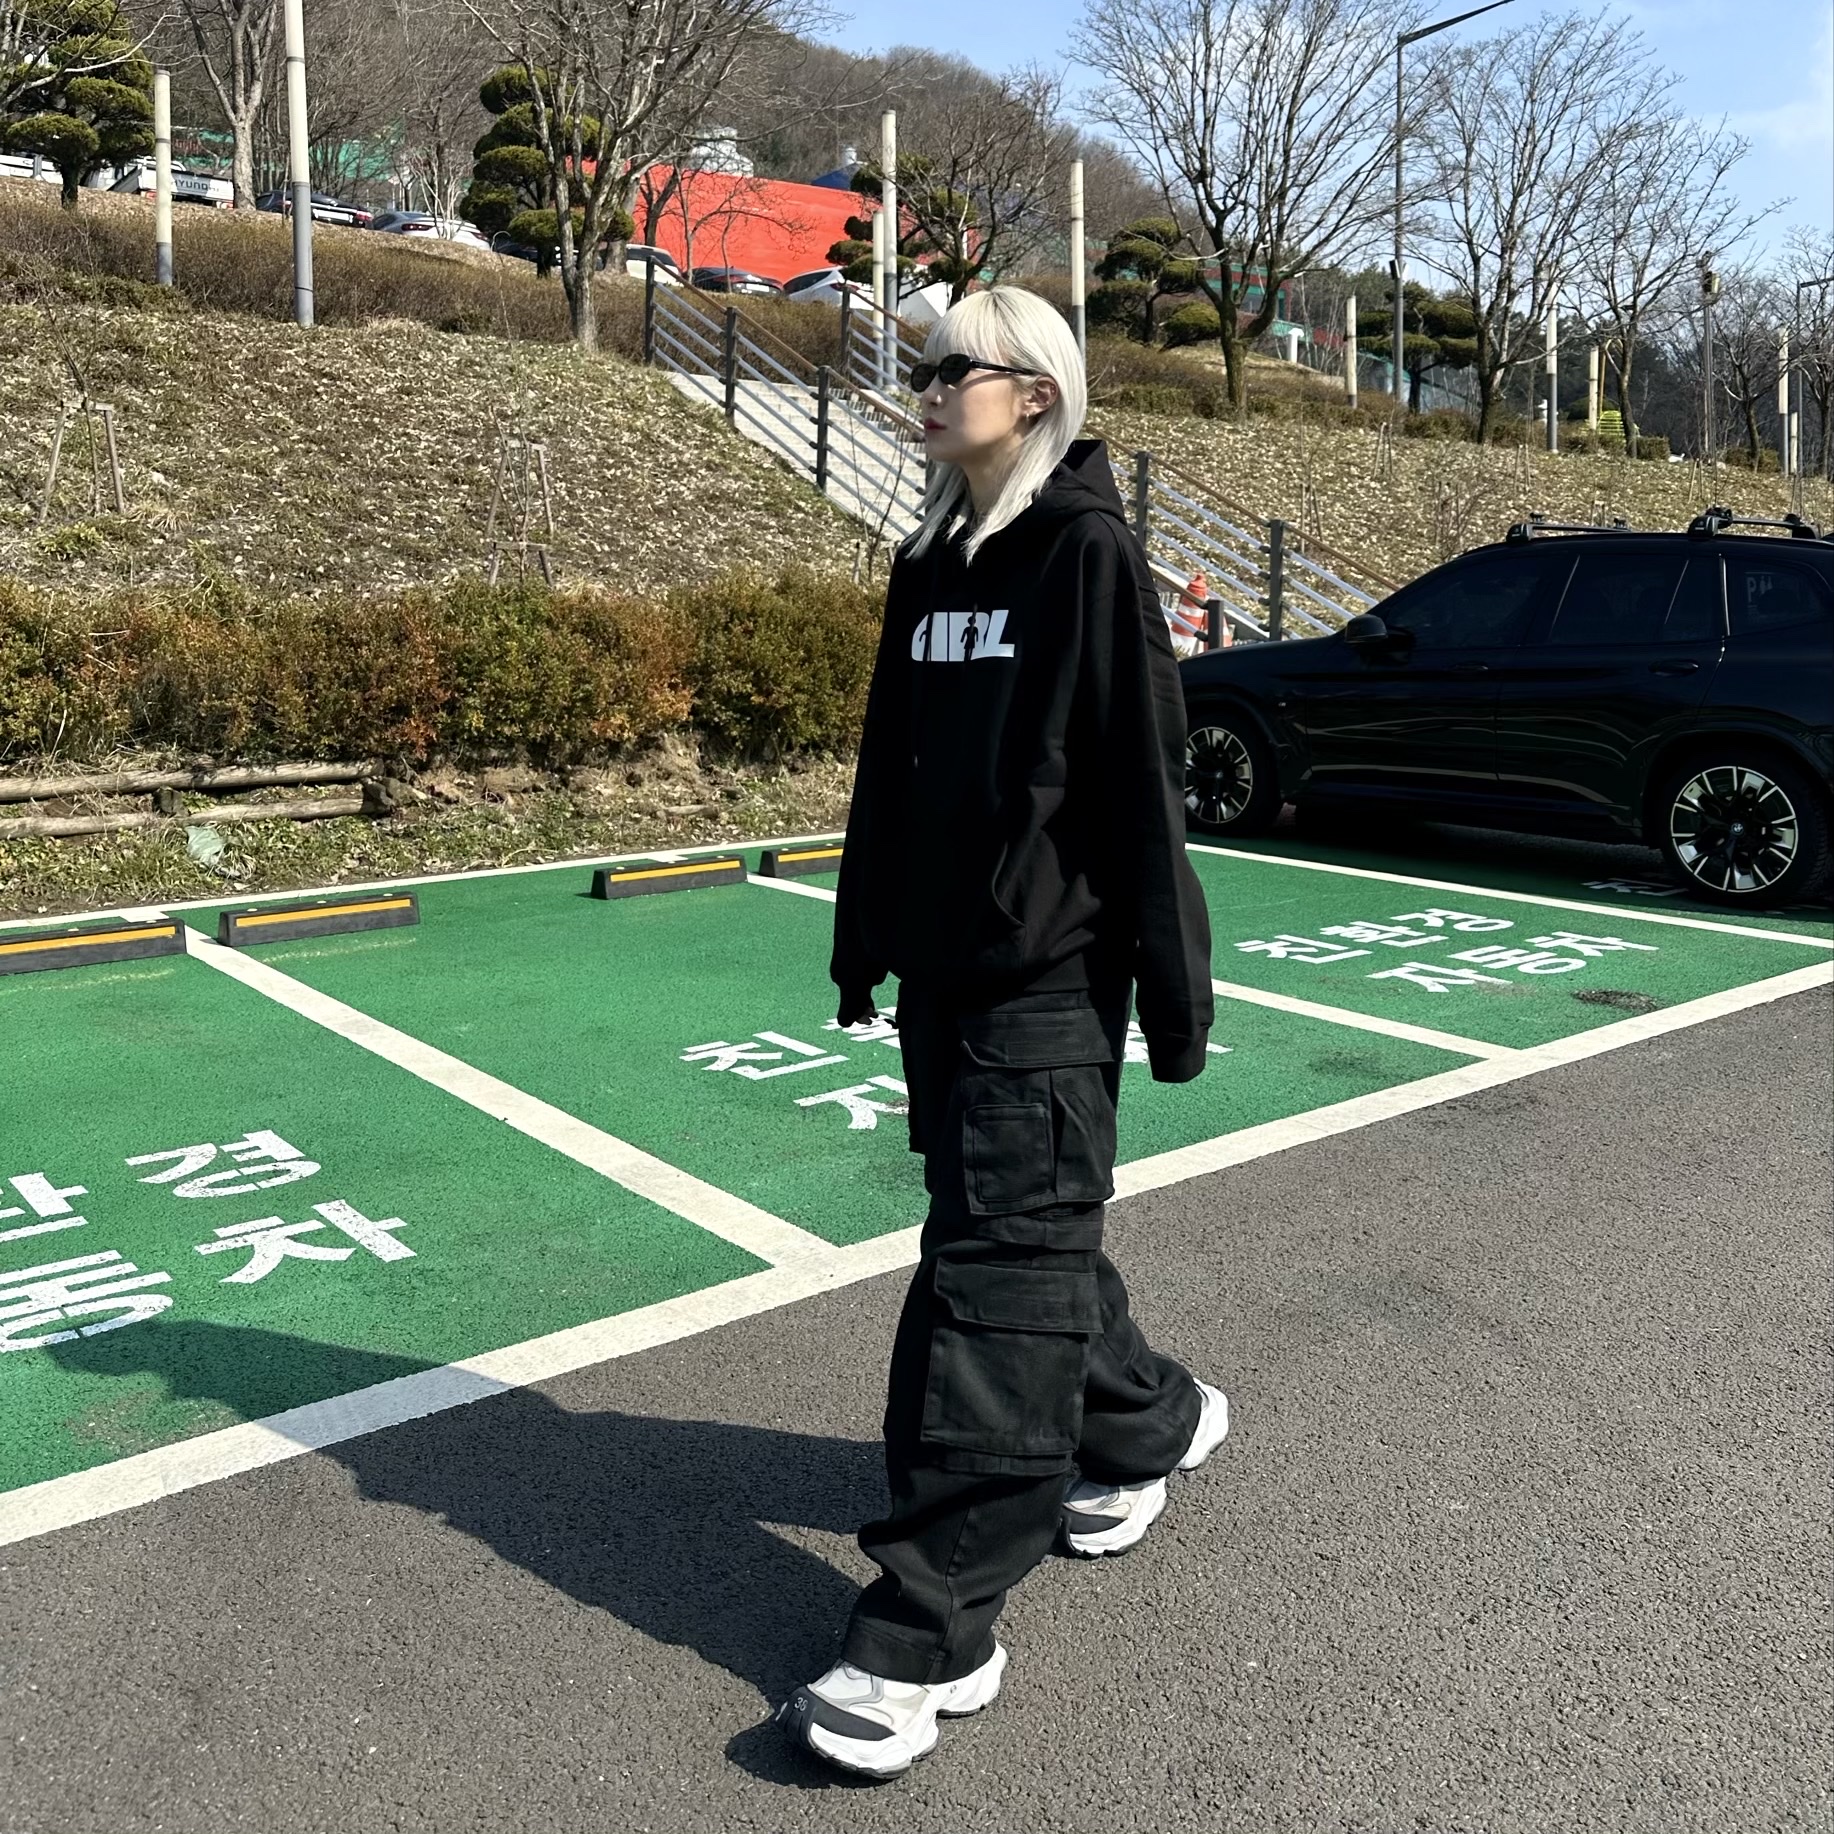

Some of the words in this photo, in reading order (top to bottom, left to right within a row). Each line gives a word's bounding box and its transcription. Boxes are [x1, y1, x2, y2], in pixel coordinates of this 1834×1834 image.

[171, 179, 220, 192] YUND
[1233, 907, 1515, 964] 친환경
[1366, 930, 1660, 993] 자동차
